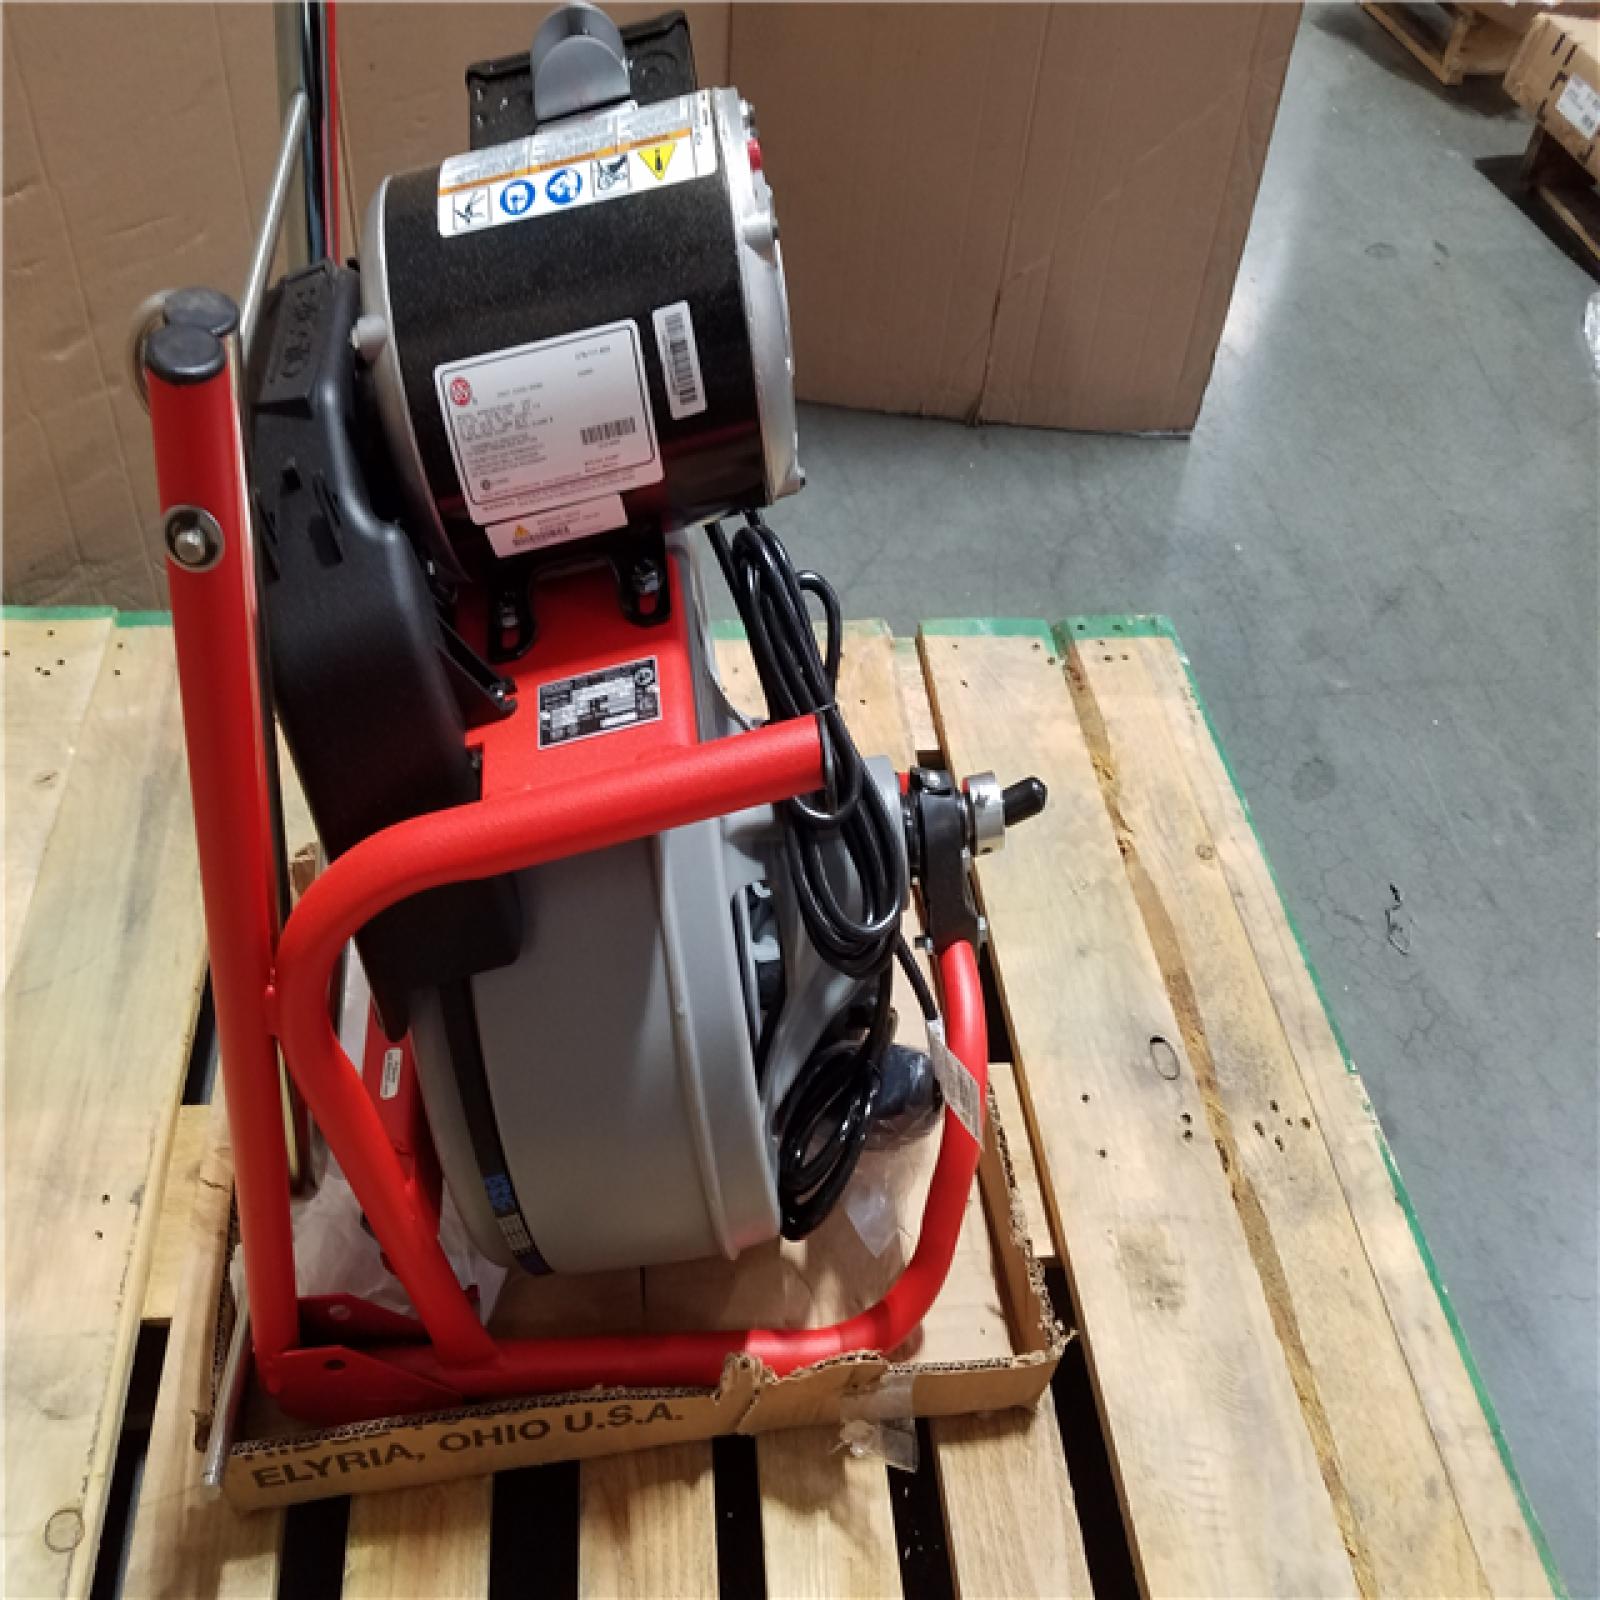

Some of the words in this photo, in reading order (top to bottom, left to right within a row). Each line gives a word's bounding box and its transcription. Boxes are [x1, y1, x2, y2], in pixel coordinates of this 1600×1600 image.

[252, 1443, 426, 1488] ELYRIA,
[439, 1420, 551, 1452] OHIO
[565, 1402, 684, 1433] U.S.A.
